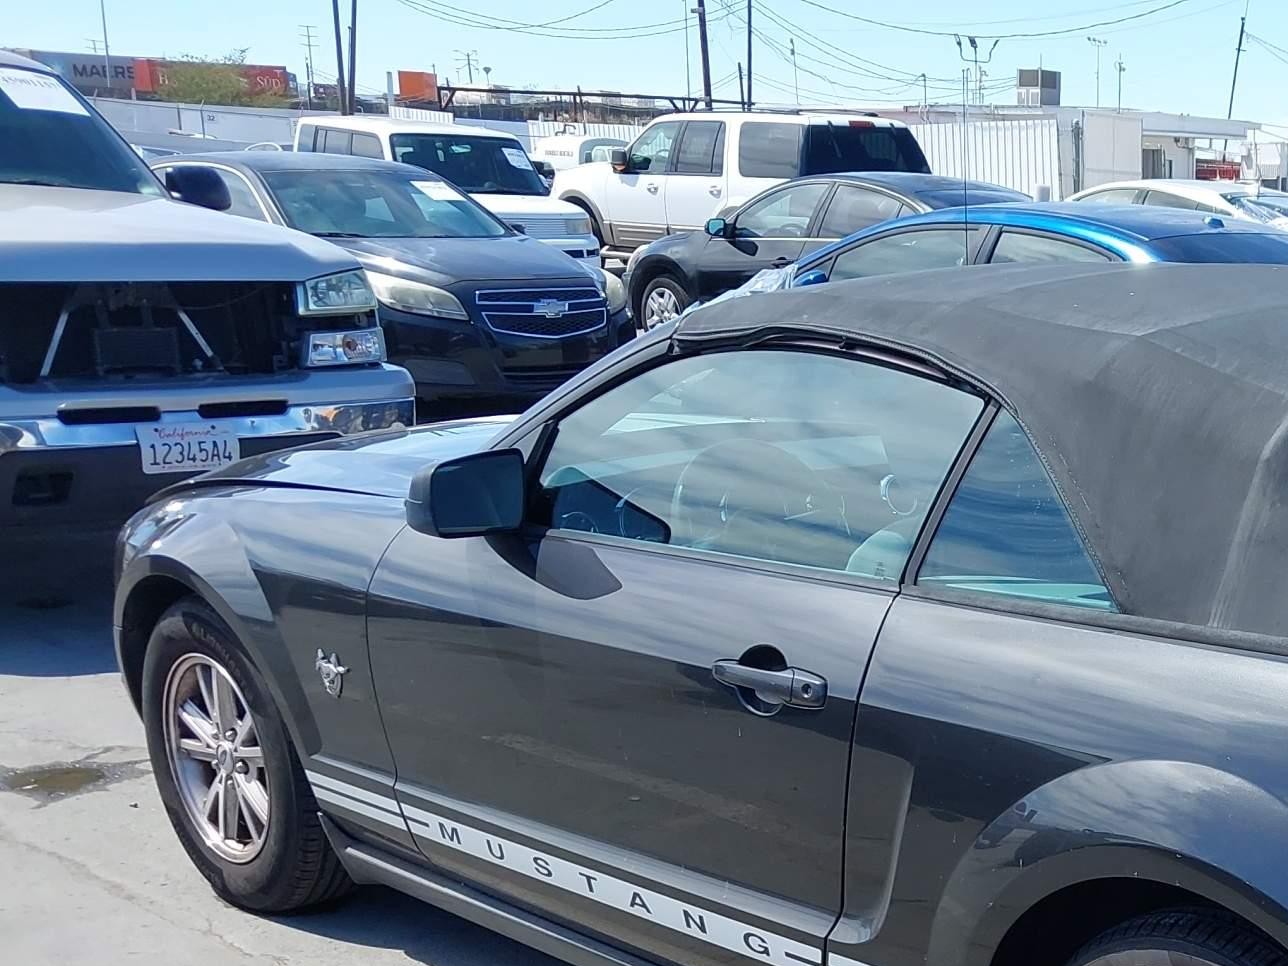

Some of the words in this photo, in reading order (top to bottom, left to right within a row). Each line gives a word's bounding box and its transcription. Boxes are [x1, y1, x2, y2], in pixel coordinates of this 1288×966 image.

[158, 426, 216, 440] California
[149, 439, 233, 467] 12345A4
[438, 821, 772, 958] MUSTANG
